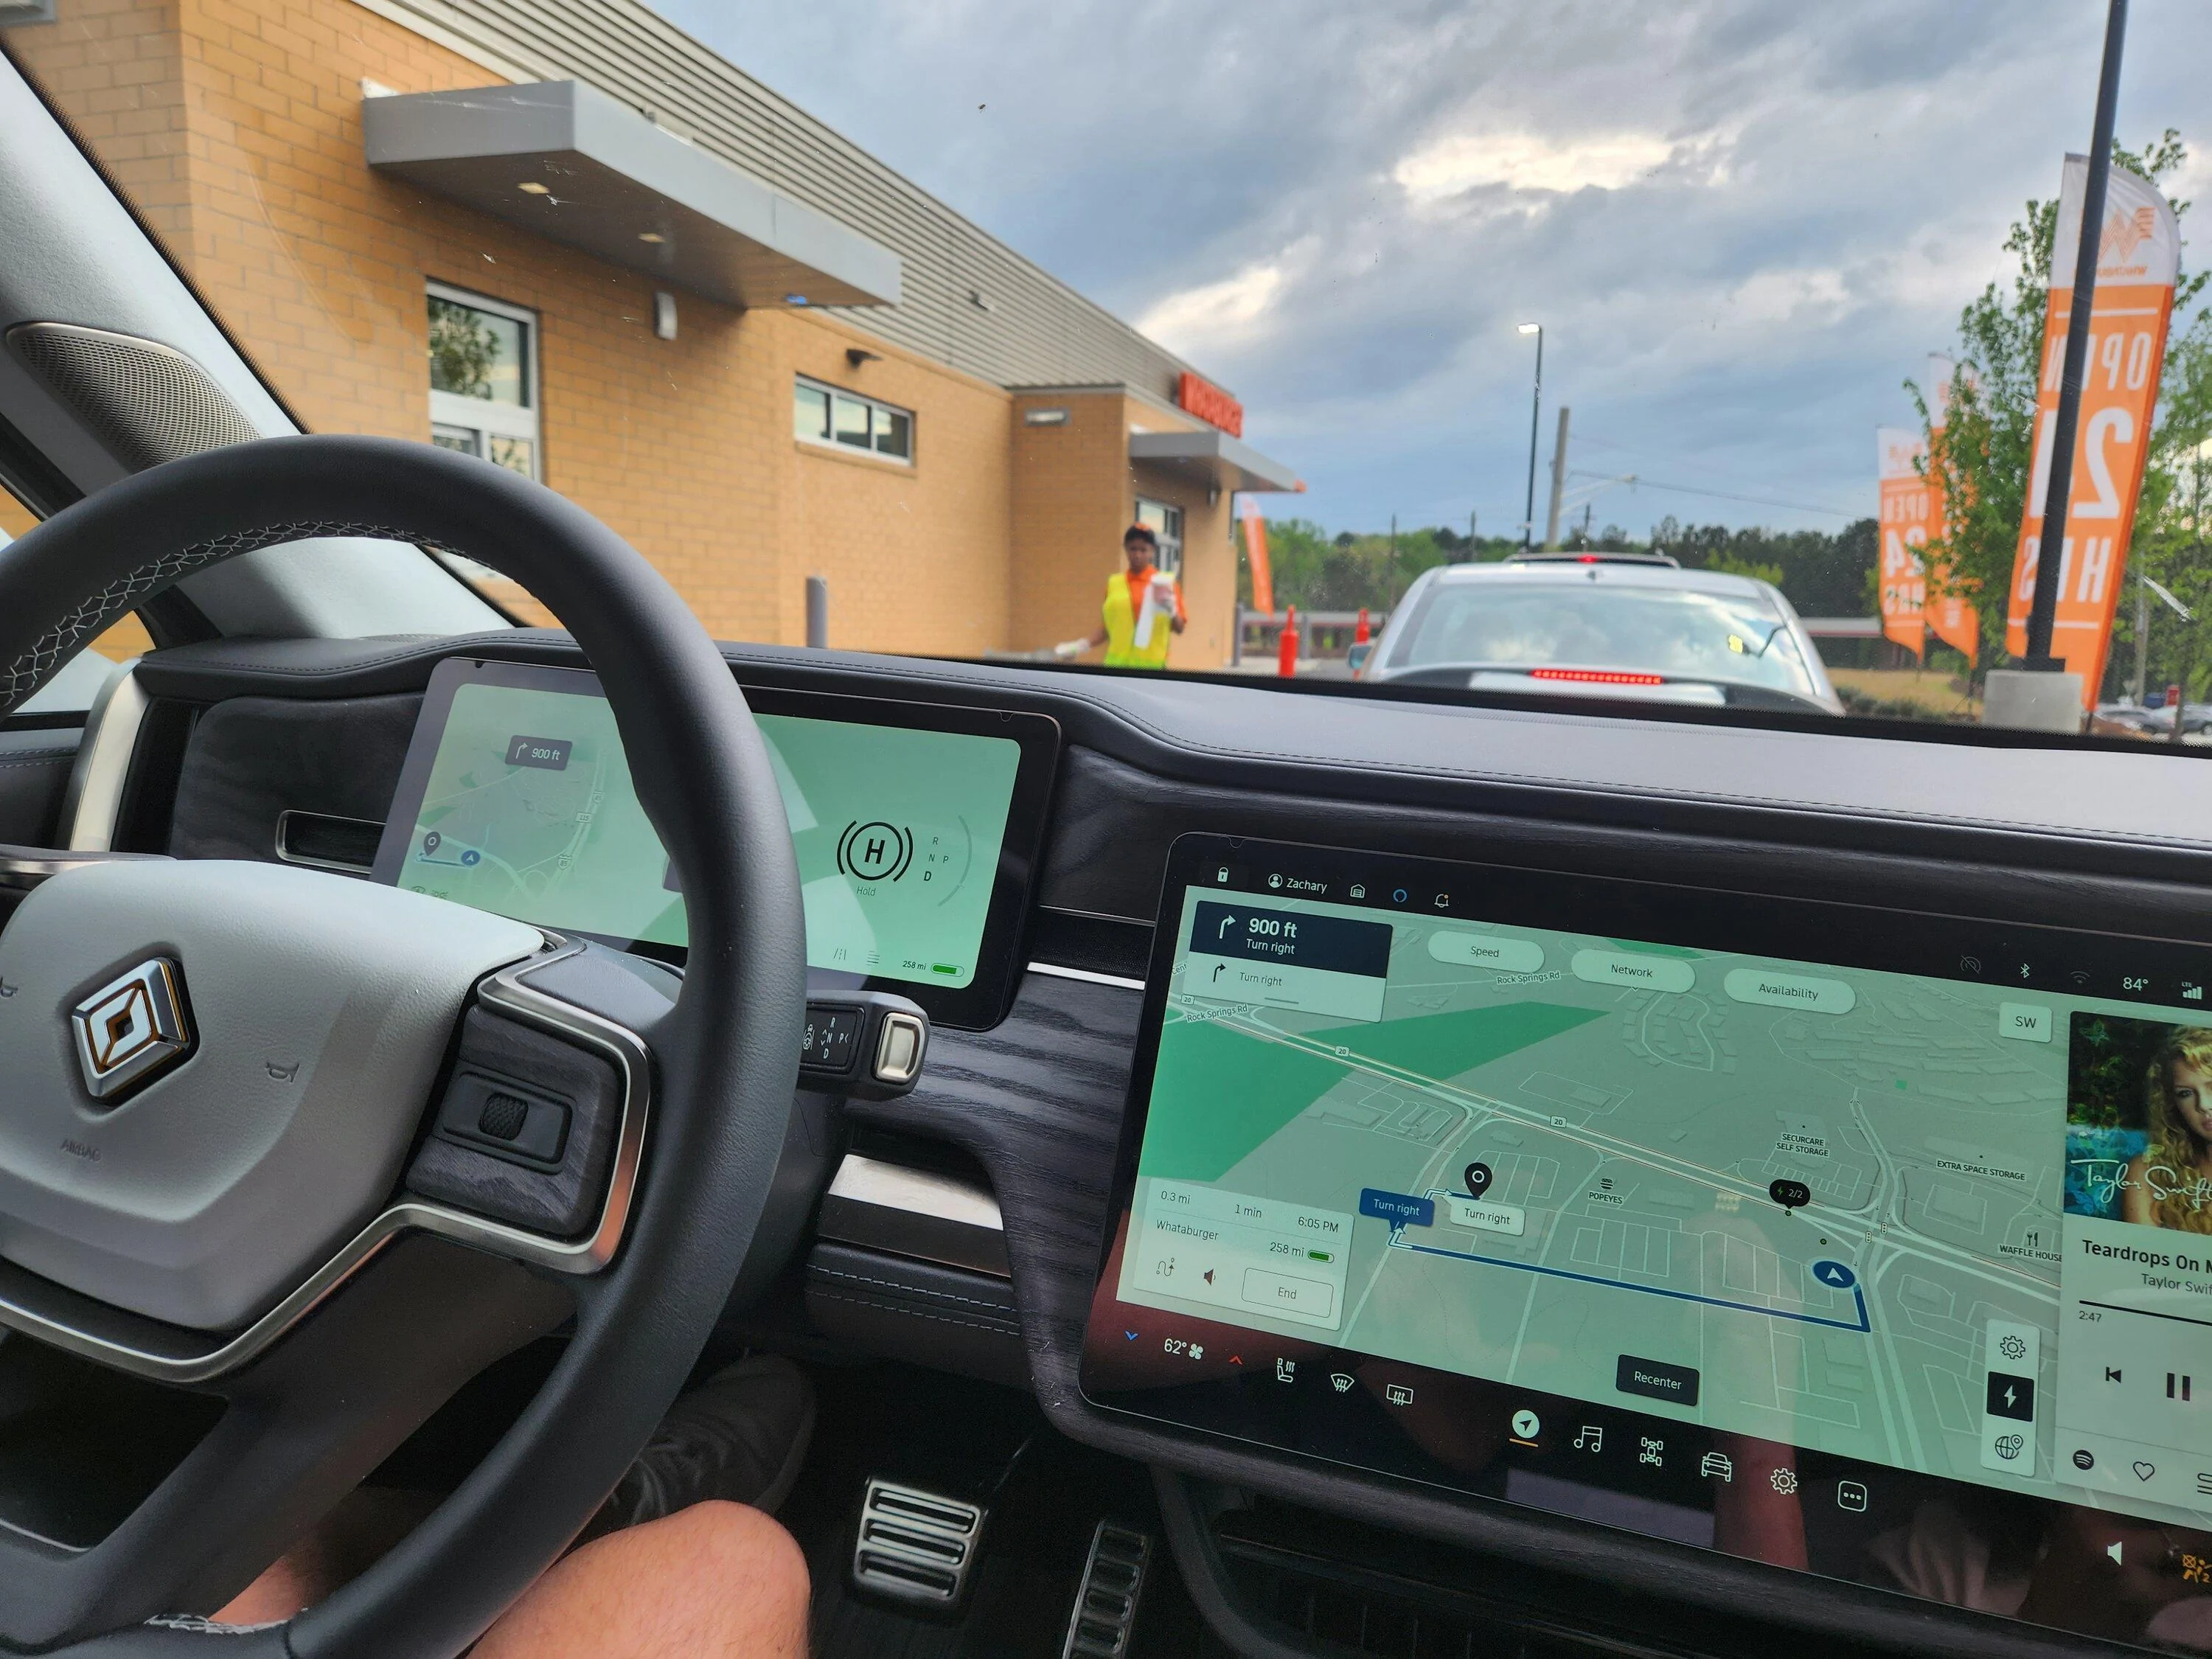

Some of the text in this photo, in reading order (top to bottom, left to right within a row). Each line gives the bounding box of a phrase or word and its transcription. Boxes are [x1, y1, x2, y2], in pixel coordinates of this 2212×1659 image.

[531, 748, 560, 760] 900 ft
[933, 837, 939, 845] R
[929, 854, 935, 862] N
[924, 871, 932, 882] D
[856, 886, 876, 897] Hold
[1287, 877, 1327, 895] Zachary
[1248, 917, 1297, 939] 900 ft
[1246, 939, 1295, 956] Turn right
[1470, 945, 1500, 959] Speed
[902, 960, 927, 971] 258 mi
[1611, 964, 1653, 978] Network
[1239, 971, 1282, 987] Turn right
[1497, 970, 1560, 985] Rock Springs Rd
[2123, 977, 2149, 992] 84°
[1759, 983, 1819, 1001] Availability
[1186, 1004, 1248, 1022] Rock Springs Rd
[830, 1017, 836, 1028] R
[2015, 1016, 2037, 1029] SW
[826, 1032, 844, 1043] N P
[823, 1048, 830, 1059] D
[1782, 1133, 1824, 1147] SECURCARE
[1776, 1142, 1829, 1157] SELF STORAGE
[1937, 1160, 2025, 1181] EXTRA SPACE STORAGE
[1161, 1191, 1191, 1205] 0.3 mi
[1589, 1192, 1623, 1204] POPEYES
[1789, 1189, 1803, 1199] 2/2
[1235, 1204, 1262, 1218] 1 min
[1374, 1198, 1420, 1217] Turn right
[1464, 1208, 1511, 1225] Turn right
[1156, 1220, 1219, 1241] Whataburger
[1298, 1217, 1339, 1233] 6:05 PM
[1270, 1242, 1304, 1257] 258 mi
[1999, 1245, 2062, 1262] WAFFLE HOUSE
[2082, 1239, 2170, 1267] Teardrops
[2176, 1255, 2199, 1272] On
[2141, 1273, 2181, 1290] Taylor
[1278, 1287, 1297, 1300] End
[2079, 1310, 2101, 1322] 2:47
[1164, 1338, 1187, 1355] 62°
[1634, 1371, 1682, 1390] Recenter
